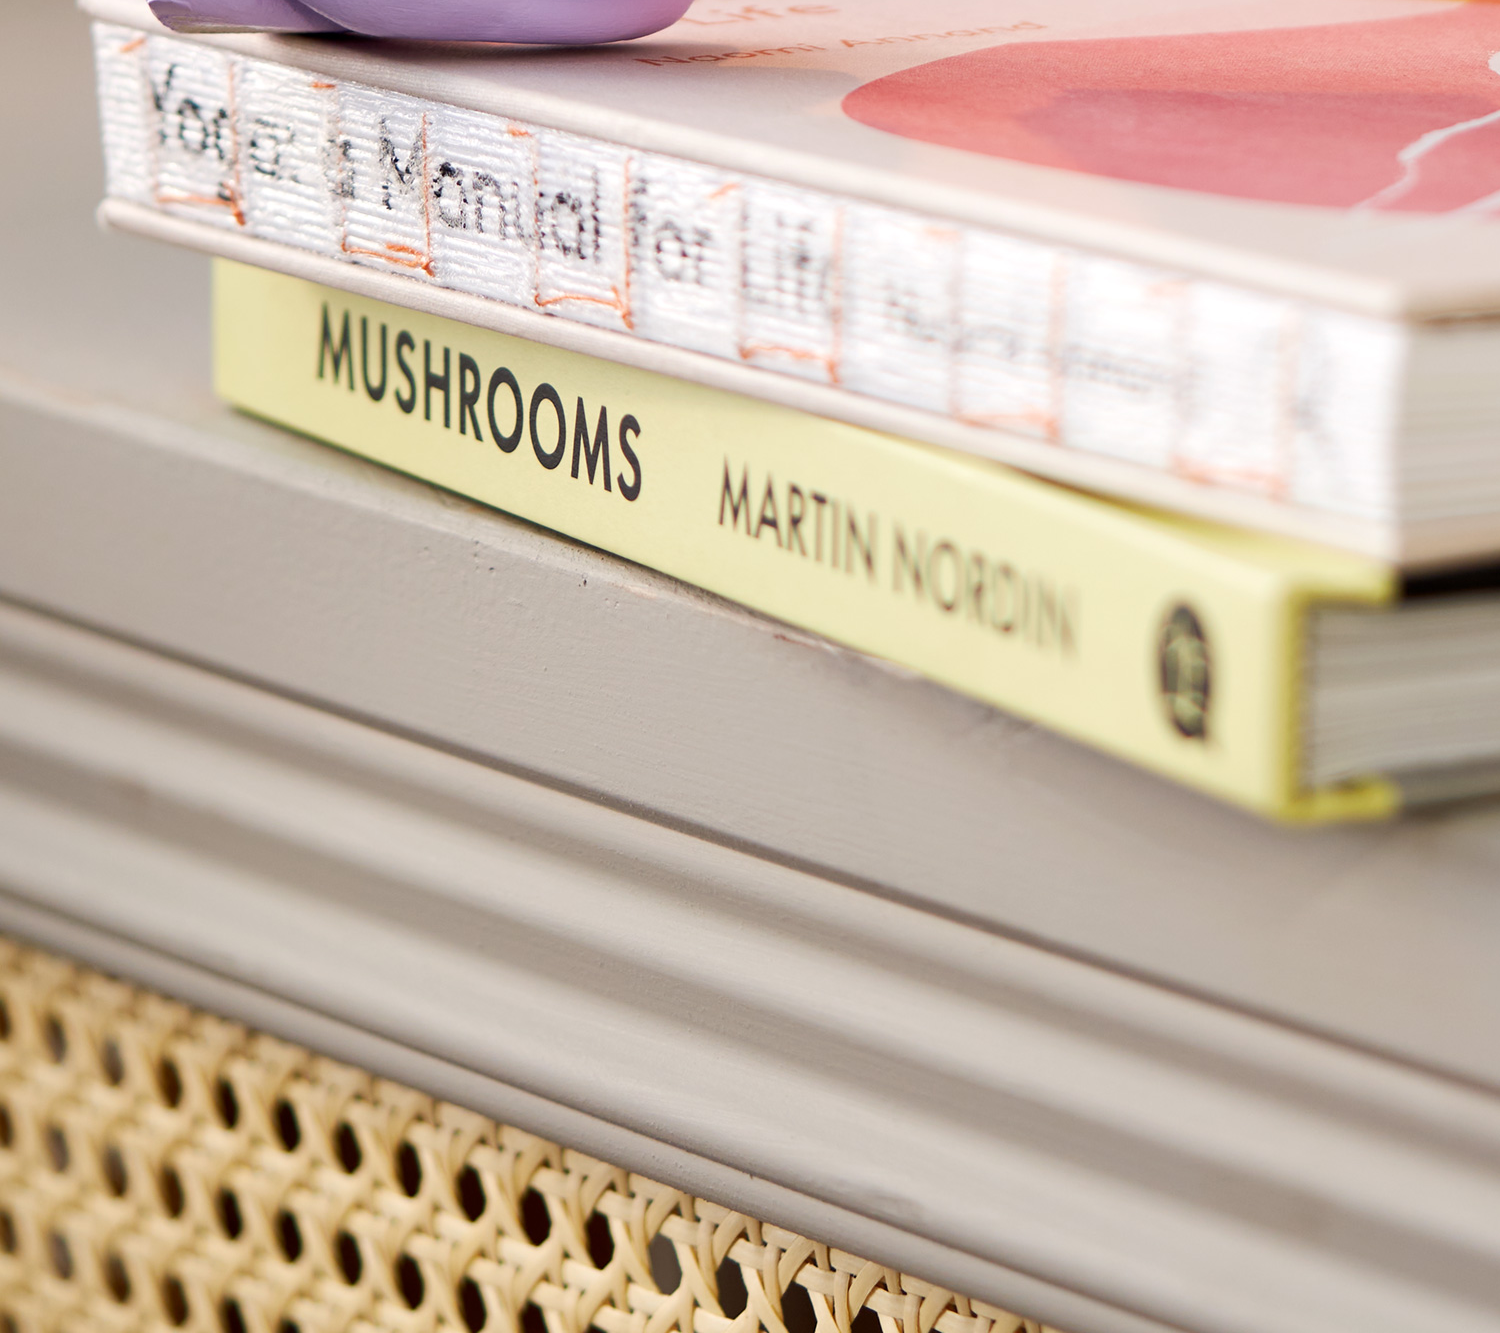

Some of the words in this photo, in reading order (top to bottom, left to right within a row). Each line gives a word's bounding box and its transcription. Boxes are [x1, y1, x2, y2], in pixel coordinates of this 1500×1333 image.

[634, 41, 828, 68] Naomi
[839, 18, 1049, 49] Annand
[317, 301, 643, 503] MUSHROOMS
[717, 452, 879, 585] MARTIN
[891, 519, 1084, 665] NORDIN
